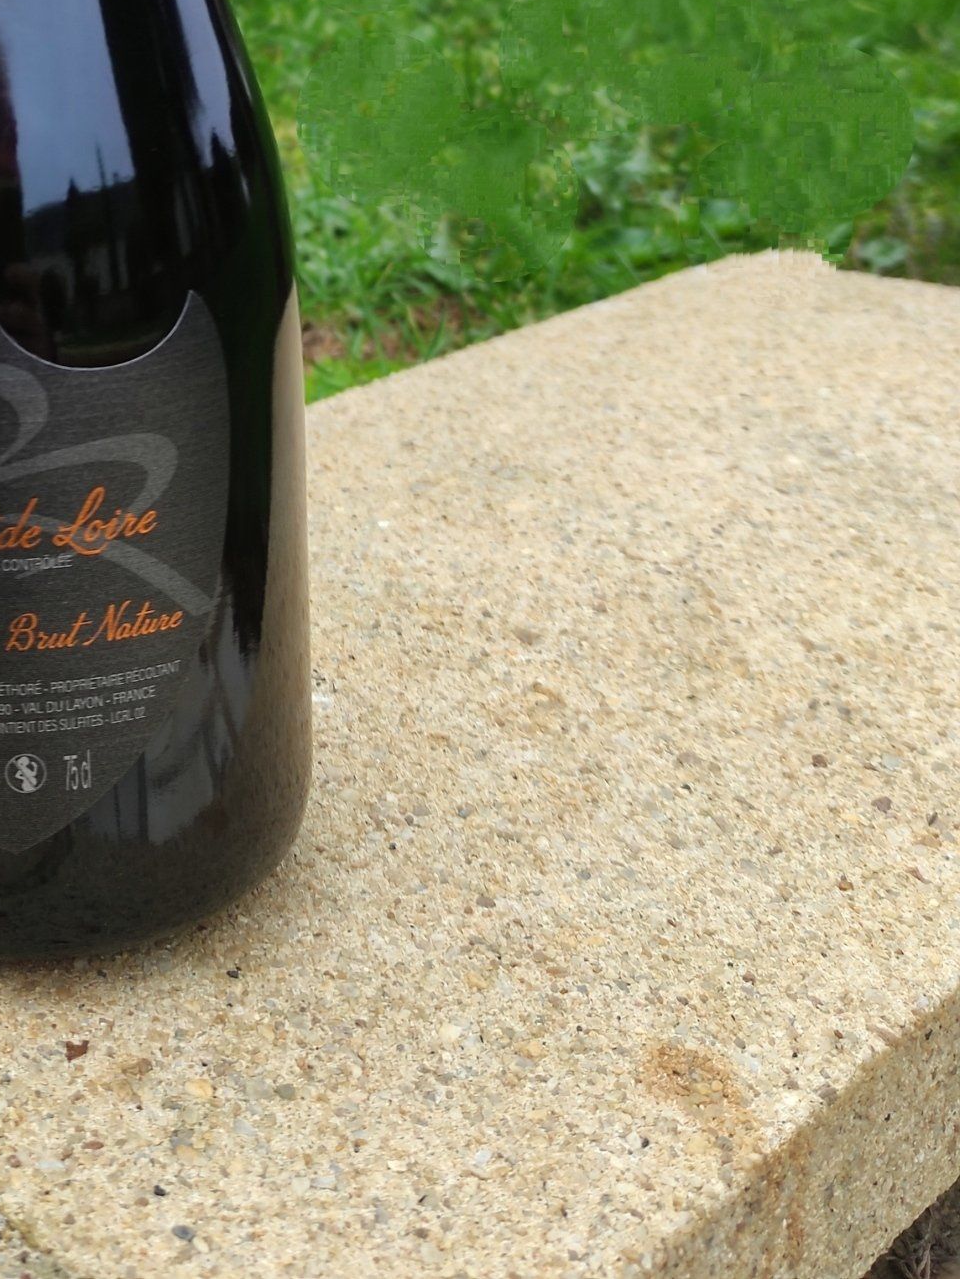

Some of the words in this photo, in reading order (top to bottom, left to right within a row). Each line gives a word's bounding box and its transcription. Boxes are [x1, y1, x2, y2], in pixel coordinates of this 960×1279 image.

[52, 485, 159, 557] Loire
[5, 612, 93, 653] Brut
[82, 599, 185, 647] Nature
[22, 702, 45, 715] VAL
[46, 700, 64, 714] DU
[65, 696, 104, 712] LAYON
[112, 685, 158, 705] FRANCE
[38, 718, 58, 733] DES
[59, 713, 104, 731] SULFITES
[63, 754, 79, 791] 75
